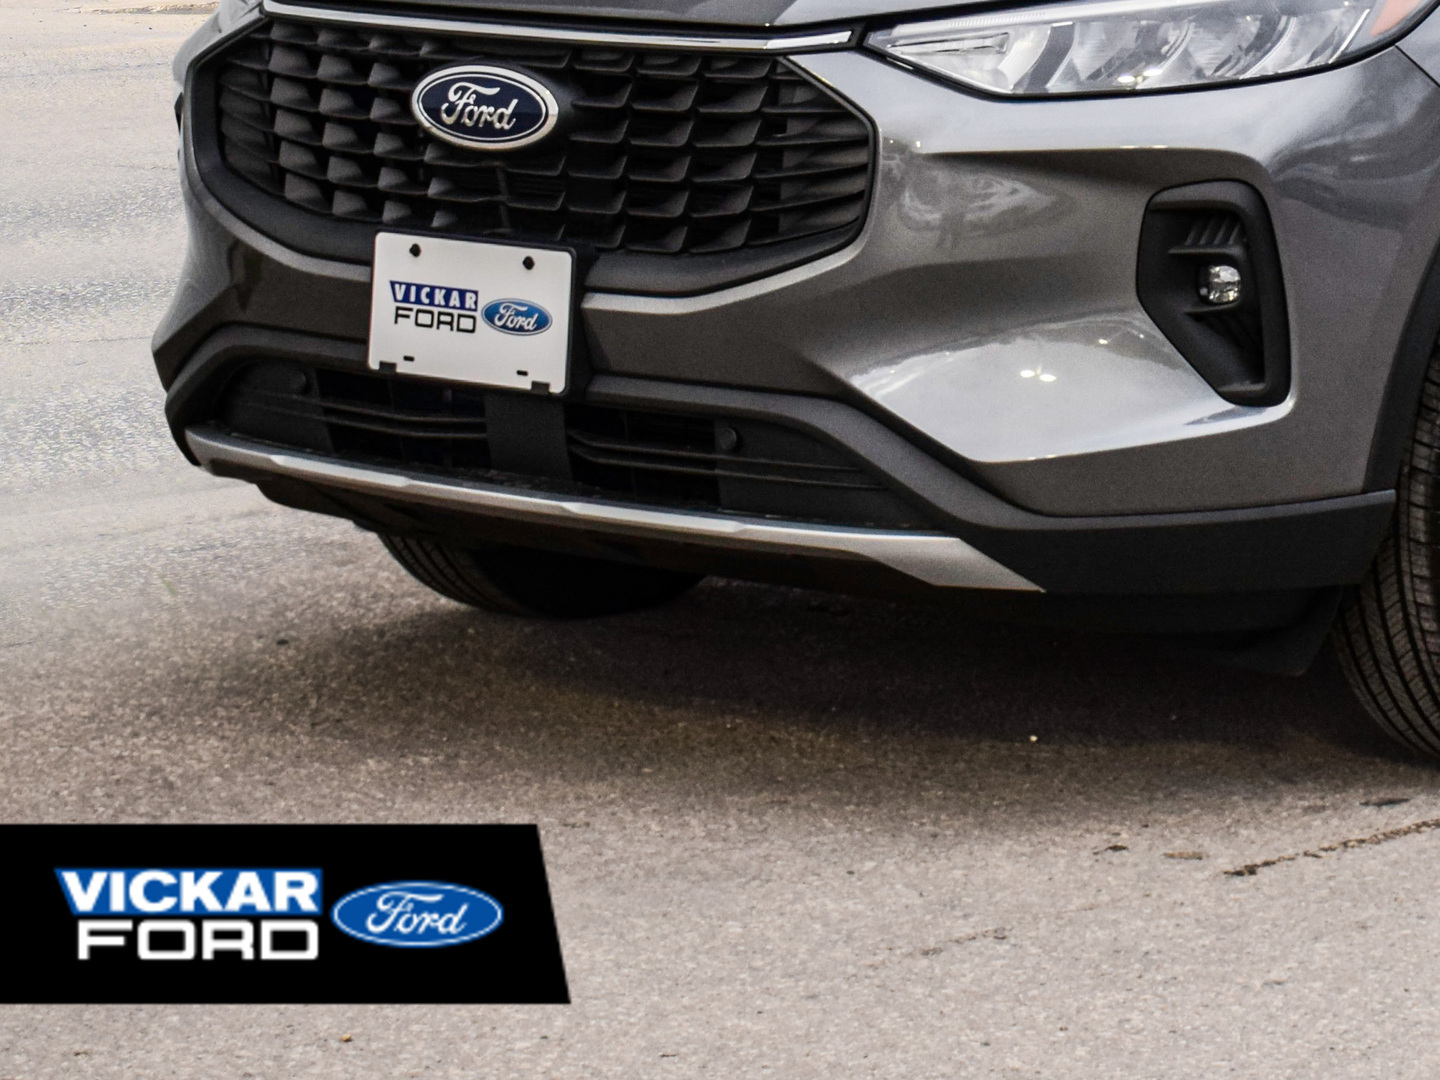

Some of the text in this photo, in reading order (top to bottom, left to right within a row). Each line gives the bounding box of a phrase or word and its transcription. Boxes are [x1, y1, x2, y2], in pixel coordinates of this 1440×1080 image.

[441, 82, 518, 130] Ford
[394, 283, 478, 310] VICKAR
[394, 306, 477, 333] FORD
[494, 302, 539, 331] Ford
